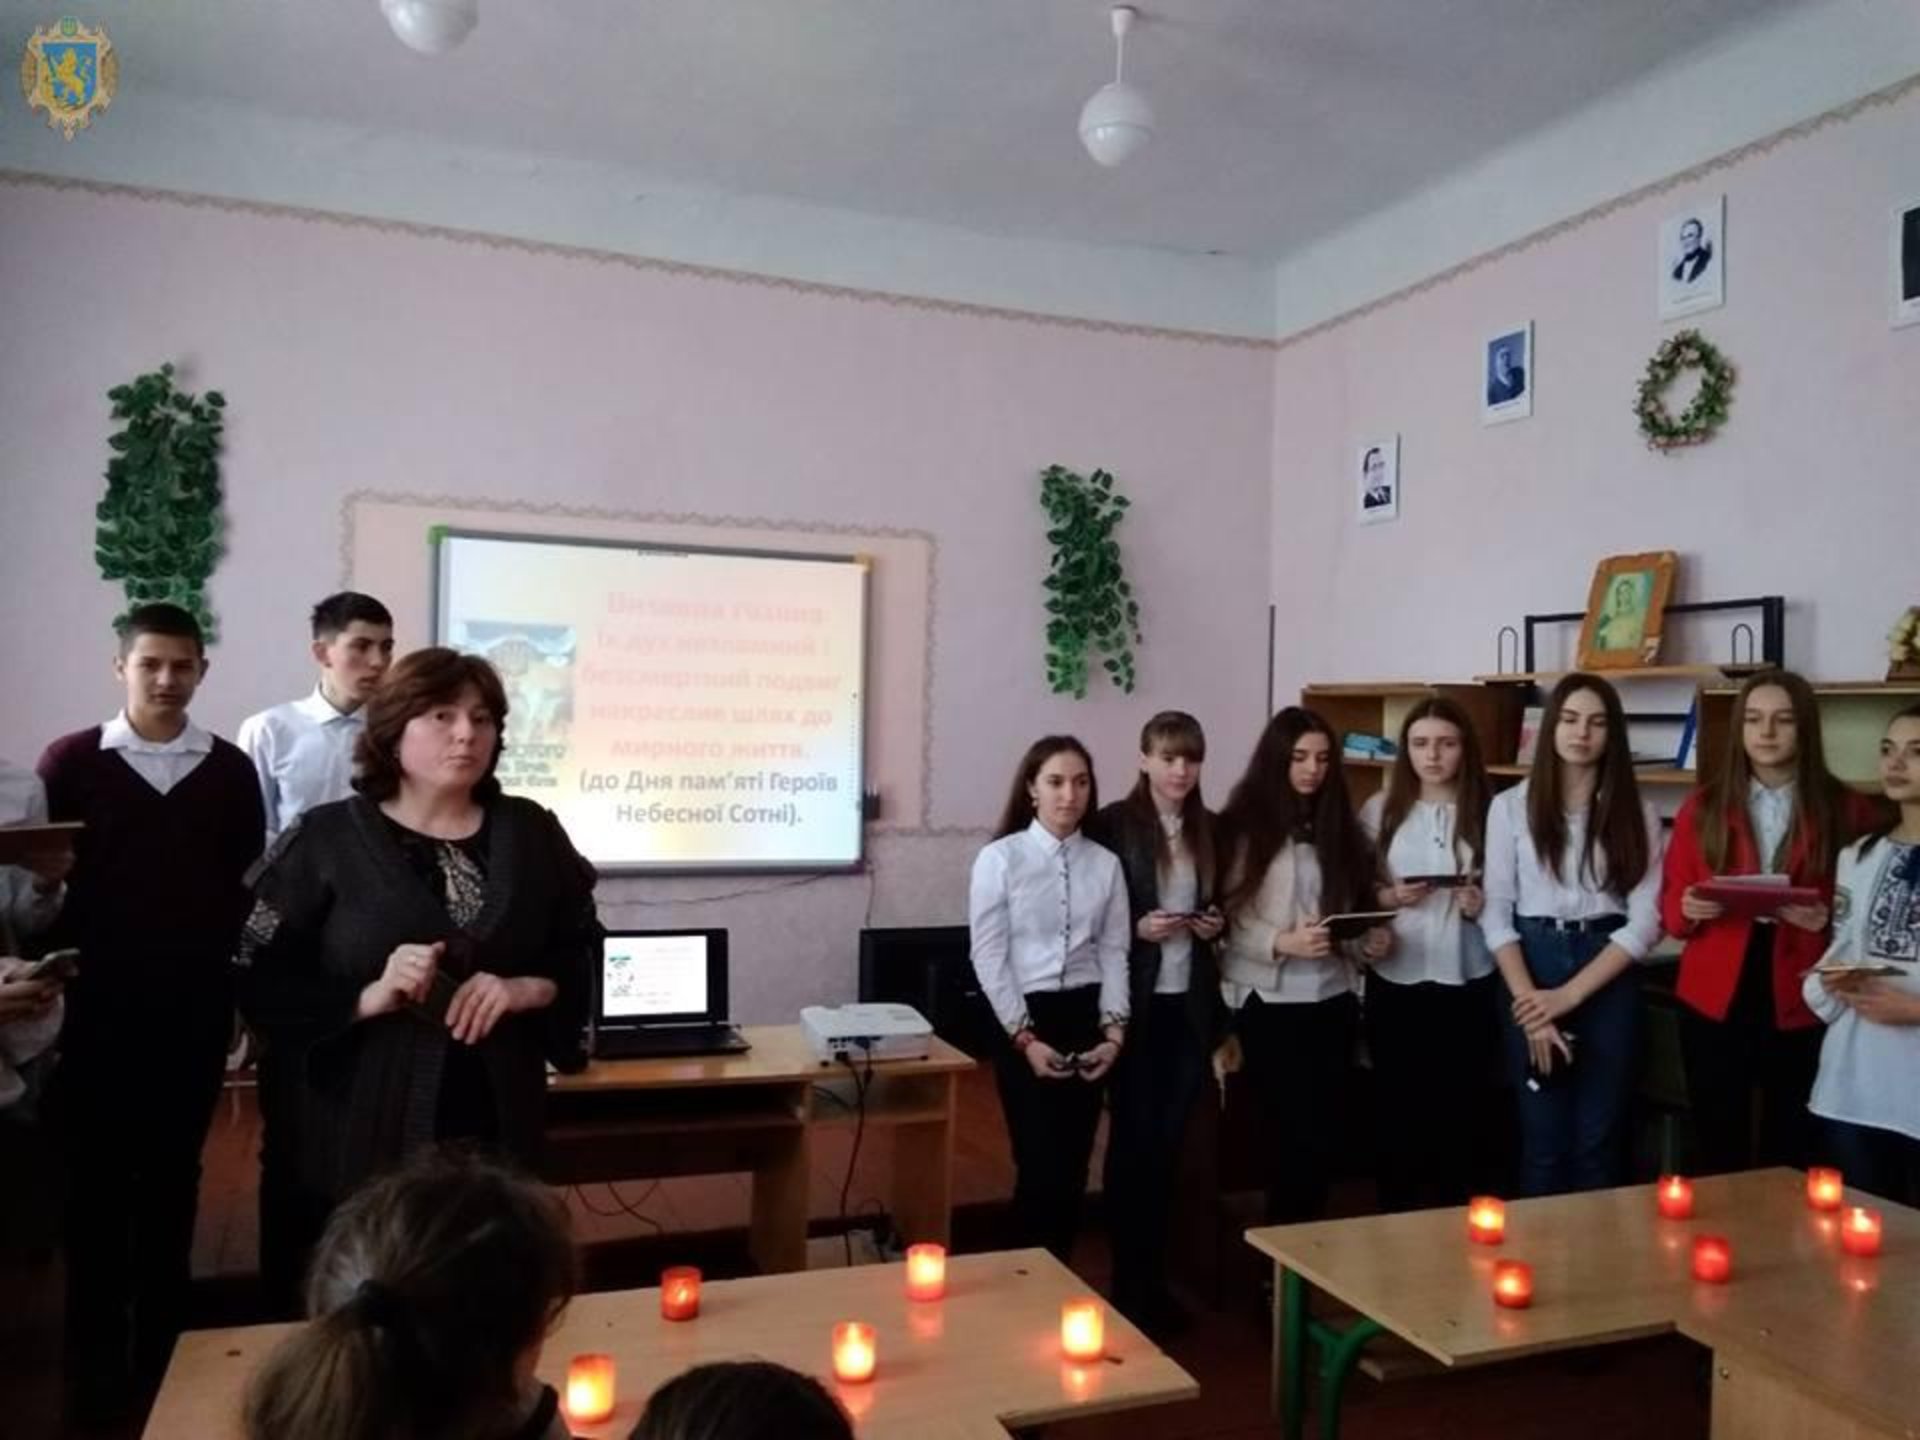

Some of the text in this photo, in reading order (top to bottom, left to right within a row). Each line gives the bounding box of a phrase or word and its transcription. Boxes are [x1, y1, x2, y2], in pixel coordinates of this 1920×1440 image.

[733, 706, 794, 725] шлях
[800, 709, 833, 729] до
[610, 739, 722, 762] мирного
[580, 768, 619, 794] (до
[625, 771, 672, 793] Дня
[769, 773, 837, 796] Героїв
[616, 804, 803, 827] Небесної Сотні).
